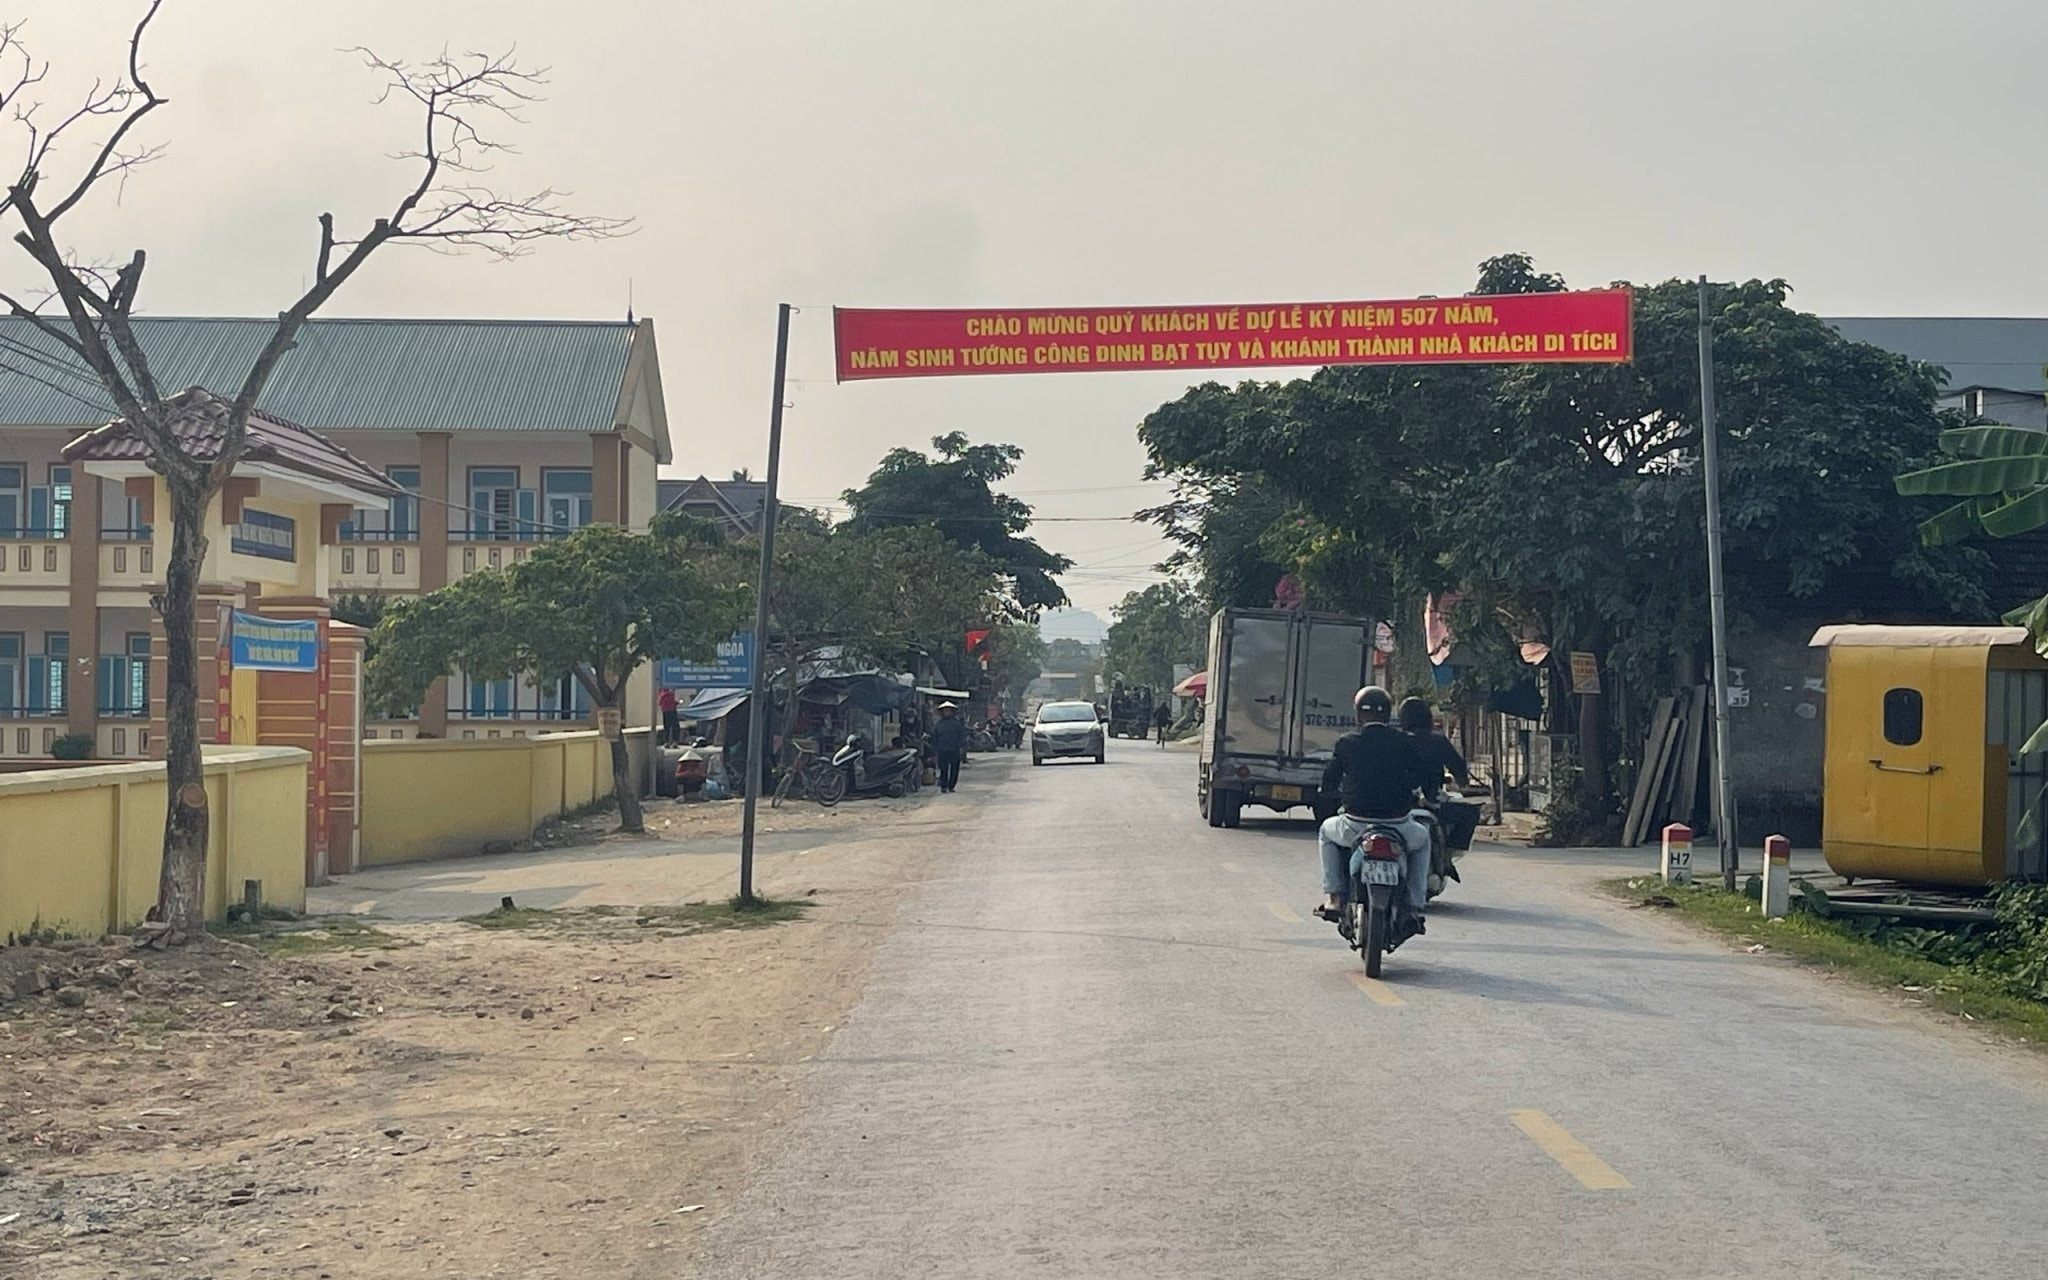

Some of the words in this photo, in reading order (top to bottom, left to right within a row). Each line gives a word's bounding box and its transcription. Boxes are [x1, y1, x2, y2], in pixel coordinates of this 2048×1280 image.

[966, 314, 1021, 337] CHÀO
[1027, 312, 1089, 335] MỪNG
[1095, 310, 1135, 335] QUÝ
[1141, 310, 1209, 332] KHÁCH
[1246, 309, 1276, 333] DỰ
[1279, 304, 1303, 329] LỄ
[1309, 303, 1335, 329] KỶ
[1341, 304, 1395, 331] NIỆM
[1400, 307, 1438, 326] 507
[1444, 302, 1499, 326] NĂM,
[850, 346, 899, 369] NĂM
[905, 348, 955, 367] SINH
[960, 344, 1028, 366] TƯỚNG
[1034, 342, 1090, 364] CÔNG
[1095, 343, 1145, 363] ĐINH
[1151, 343, 1189, 365] BẠT
[1195, 341, 1232, 363] TỤY
[1238, 337, 1265, 359] VÀ
[1270, 336, 1341, 358] KHÁNH
[1346, 334, 1414, 357] THÀNH
[1420, 332, 1463, 355] NHÀ
[1468, 331, 1538, 353] KHÁCH
[1544, 334, 1565, 352] DI
[1571, 329, 1617, 351] TÍCH
[1670, 852, 1690, 865] H7
